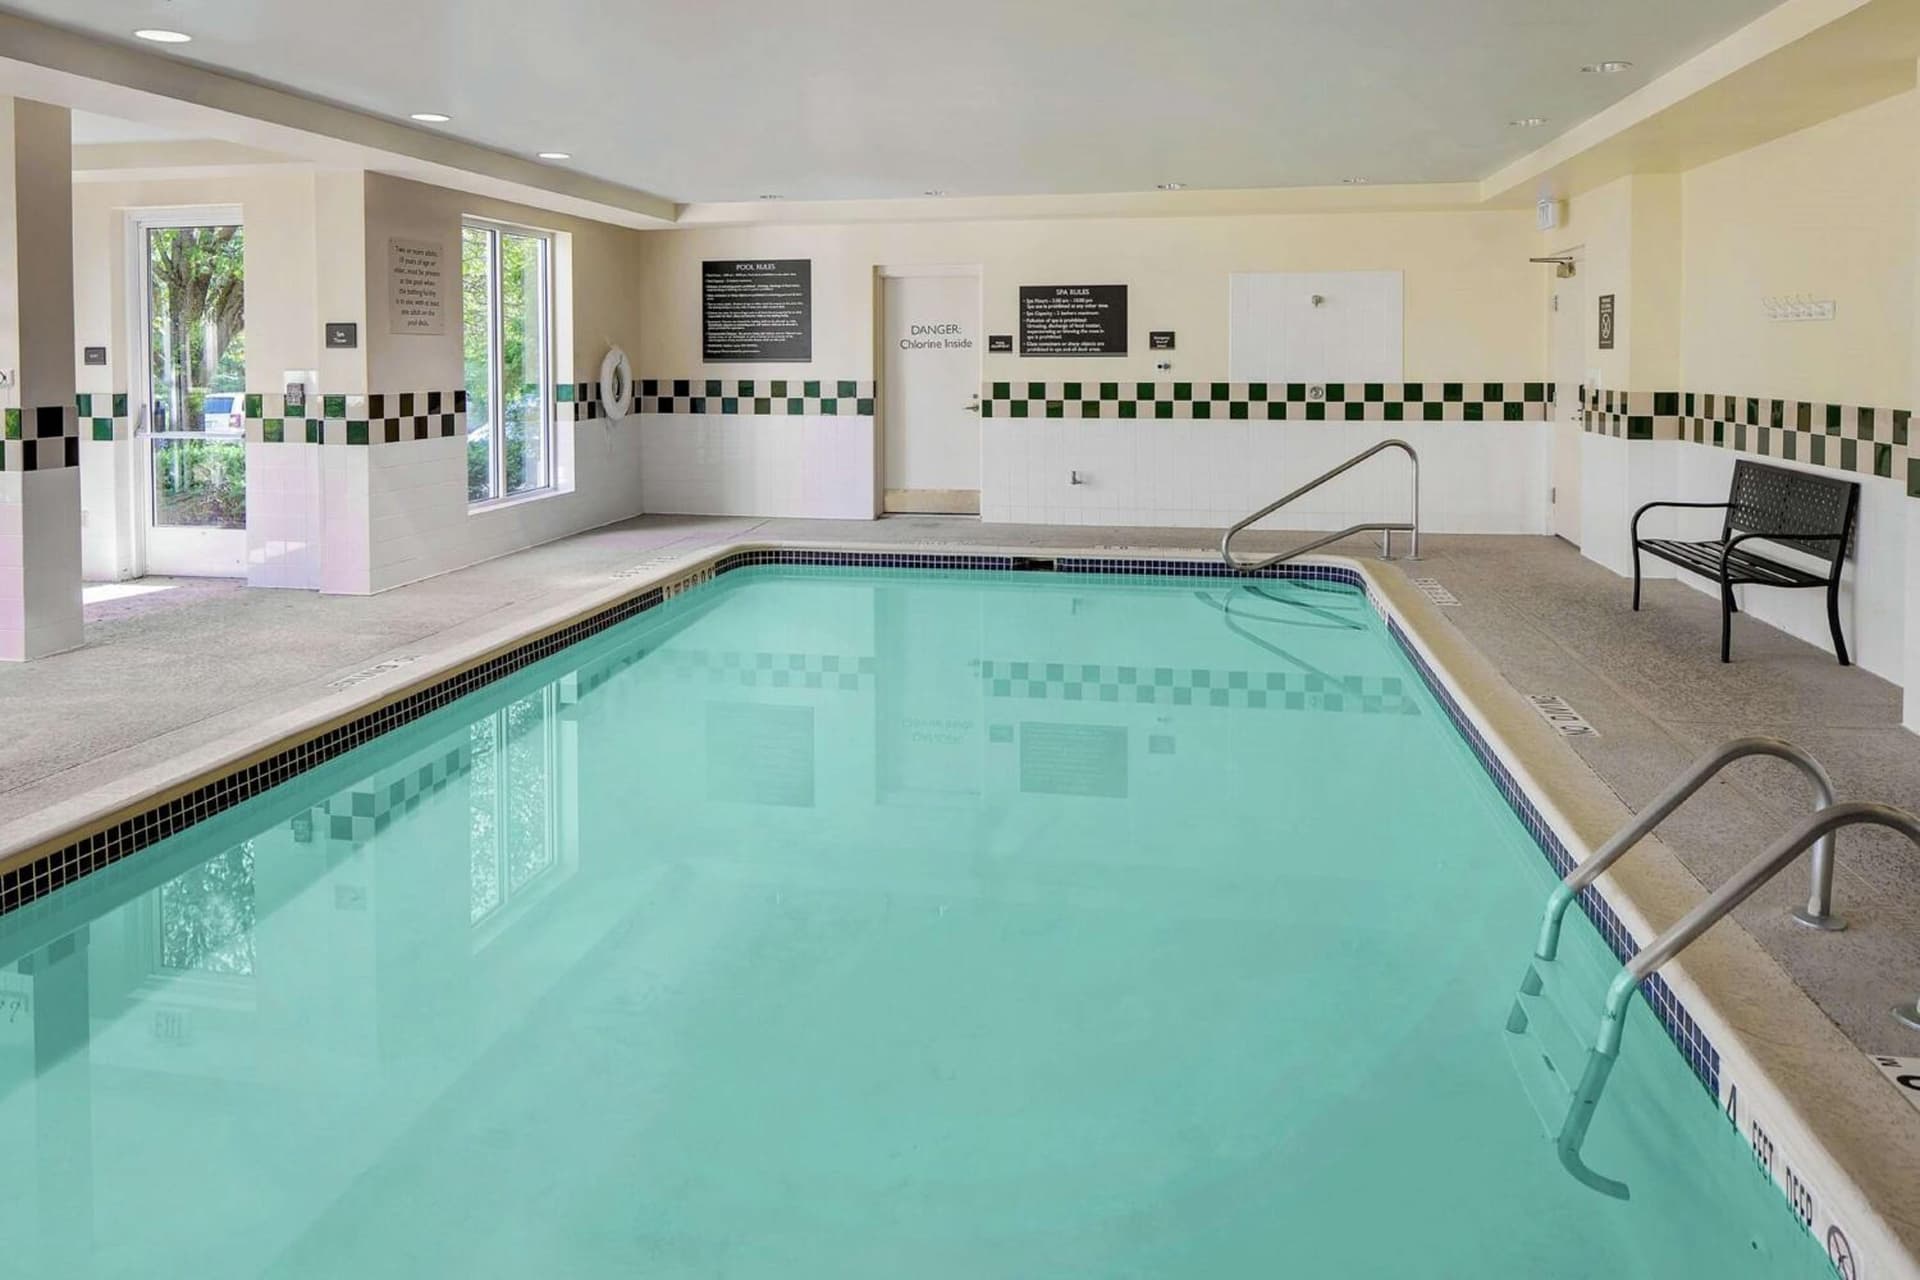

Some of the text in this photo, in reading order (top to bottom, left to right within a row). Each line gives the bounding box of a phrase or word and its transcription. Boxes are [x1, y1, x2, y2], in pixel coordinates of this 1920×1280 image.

[911, 324, 962, 335] DANGER:
[900, 338, 973, 350] Chlorine Inside
